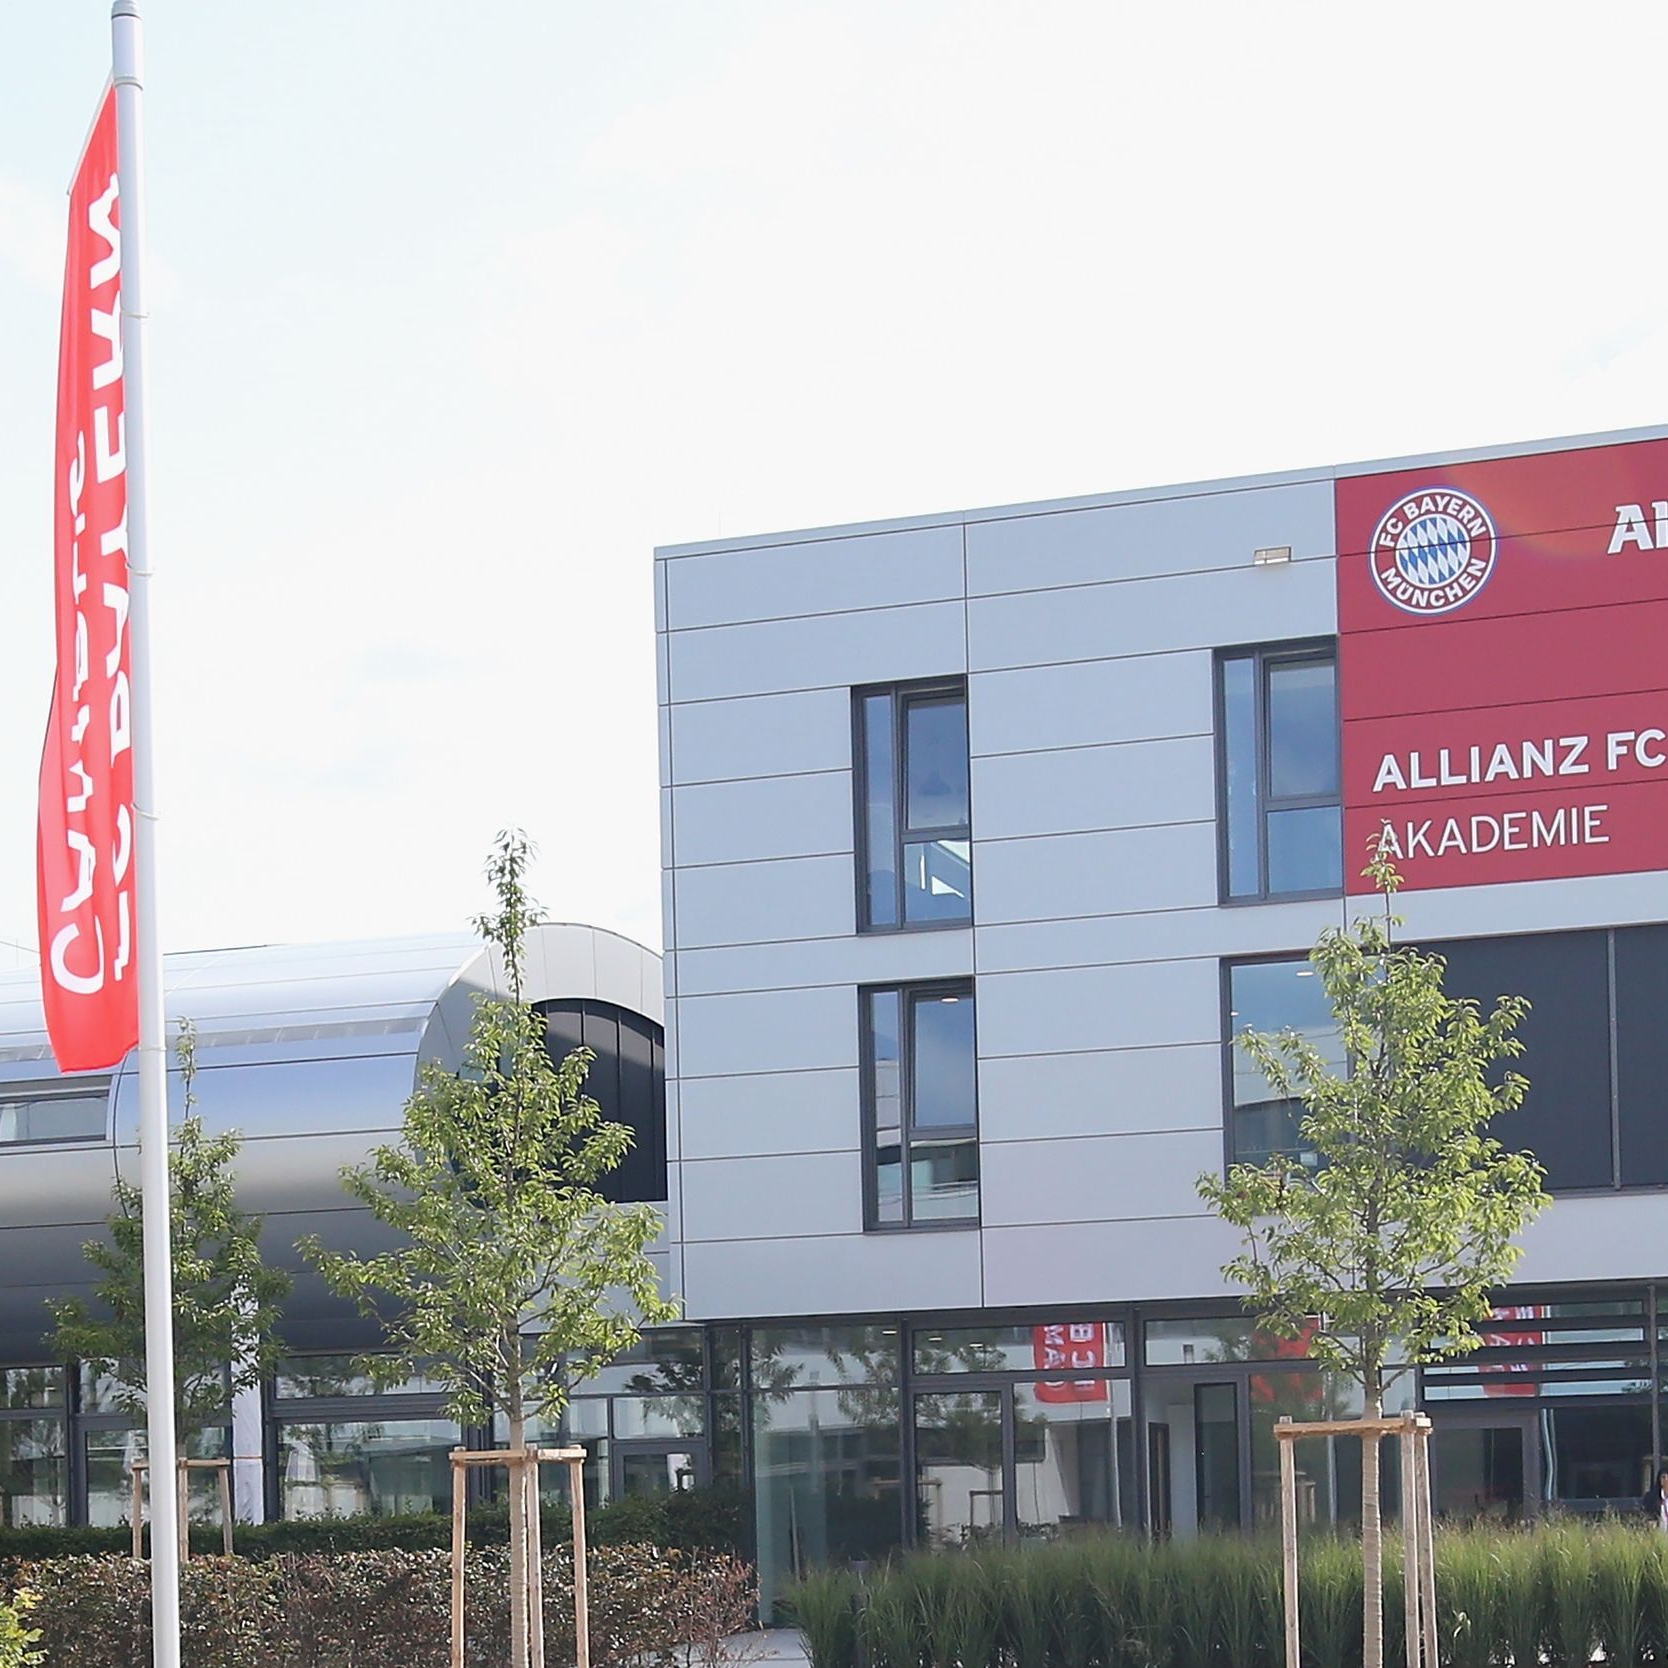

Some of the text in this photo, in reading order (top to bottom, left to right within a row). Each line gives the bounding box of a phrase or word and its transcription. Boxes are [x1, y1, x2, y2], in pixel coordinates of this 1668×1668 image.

[1379, 495, 1486, 548] FC BAYERN
[1381, 557, 1487, 608] MÜNCHEN
[1372, 735, 1589, 792] ALLIANZ
[1607, 728, 1667, 770] FC
[1374, 804, 1610, 861] AKADEMIE
